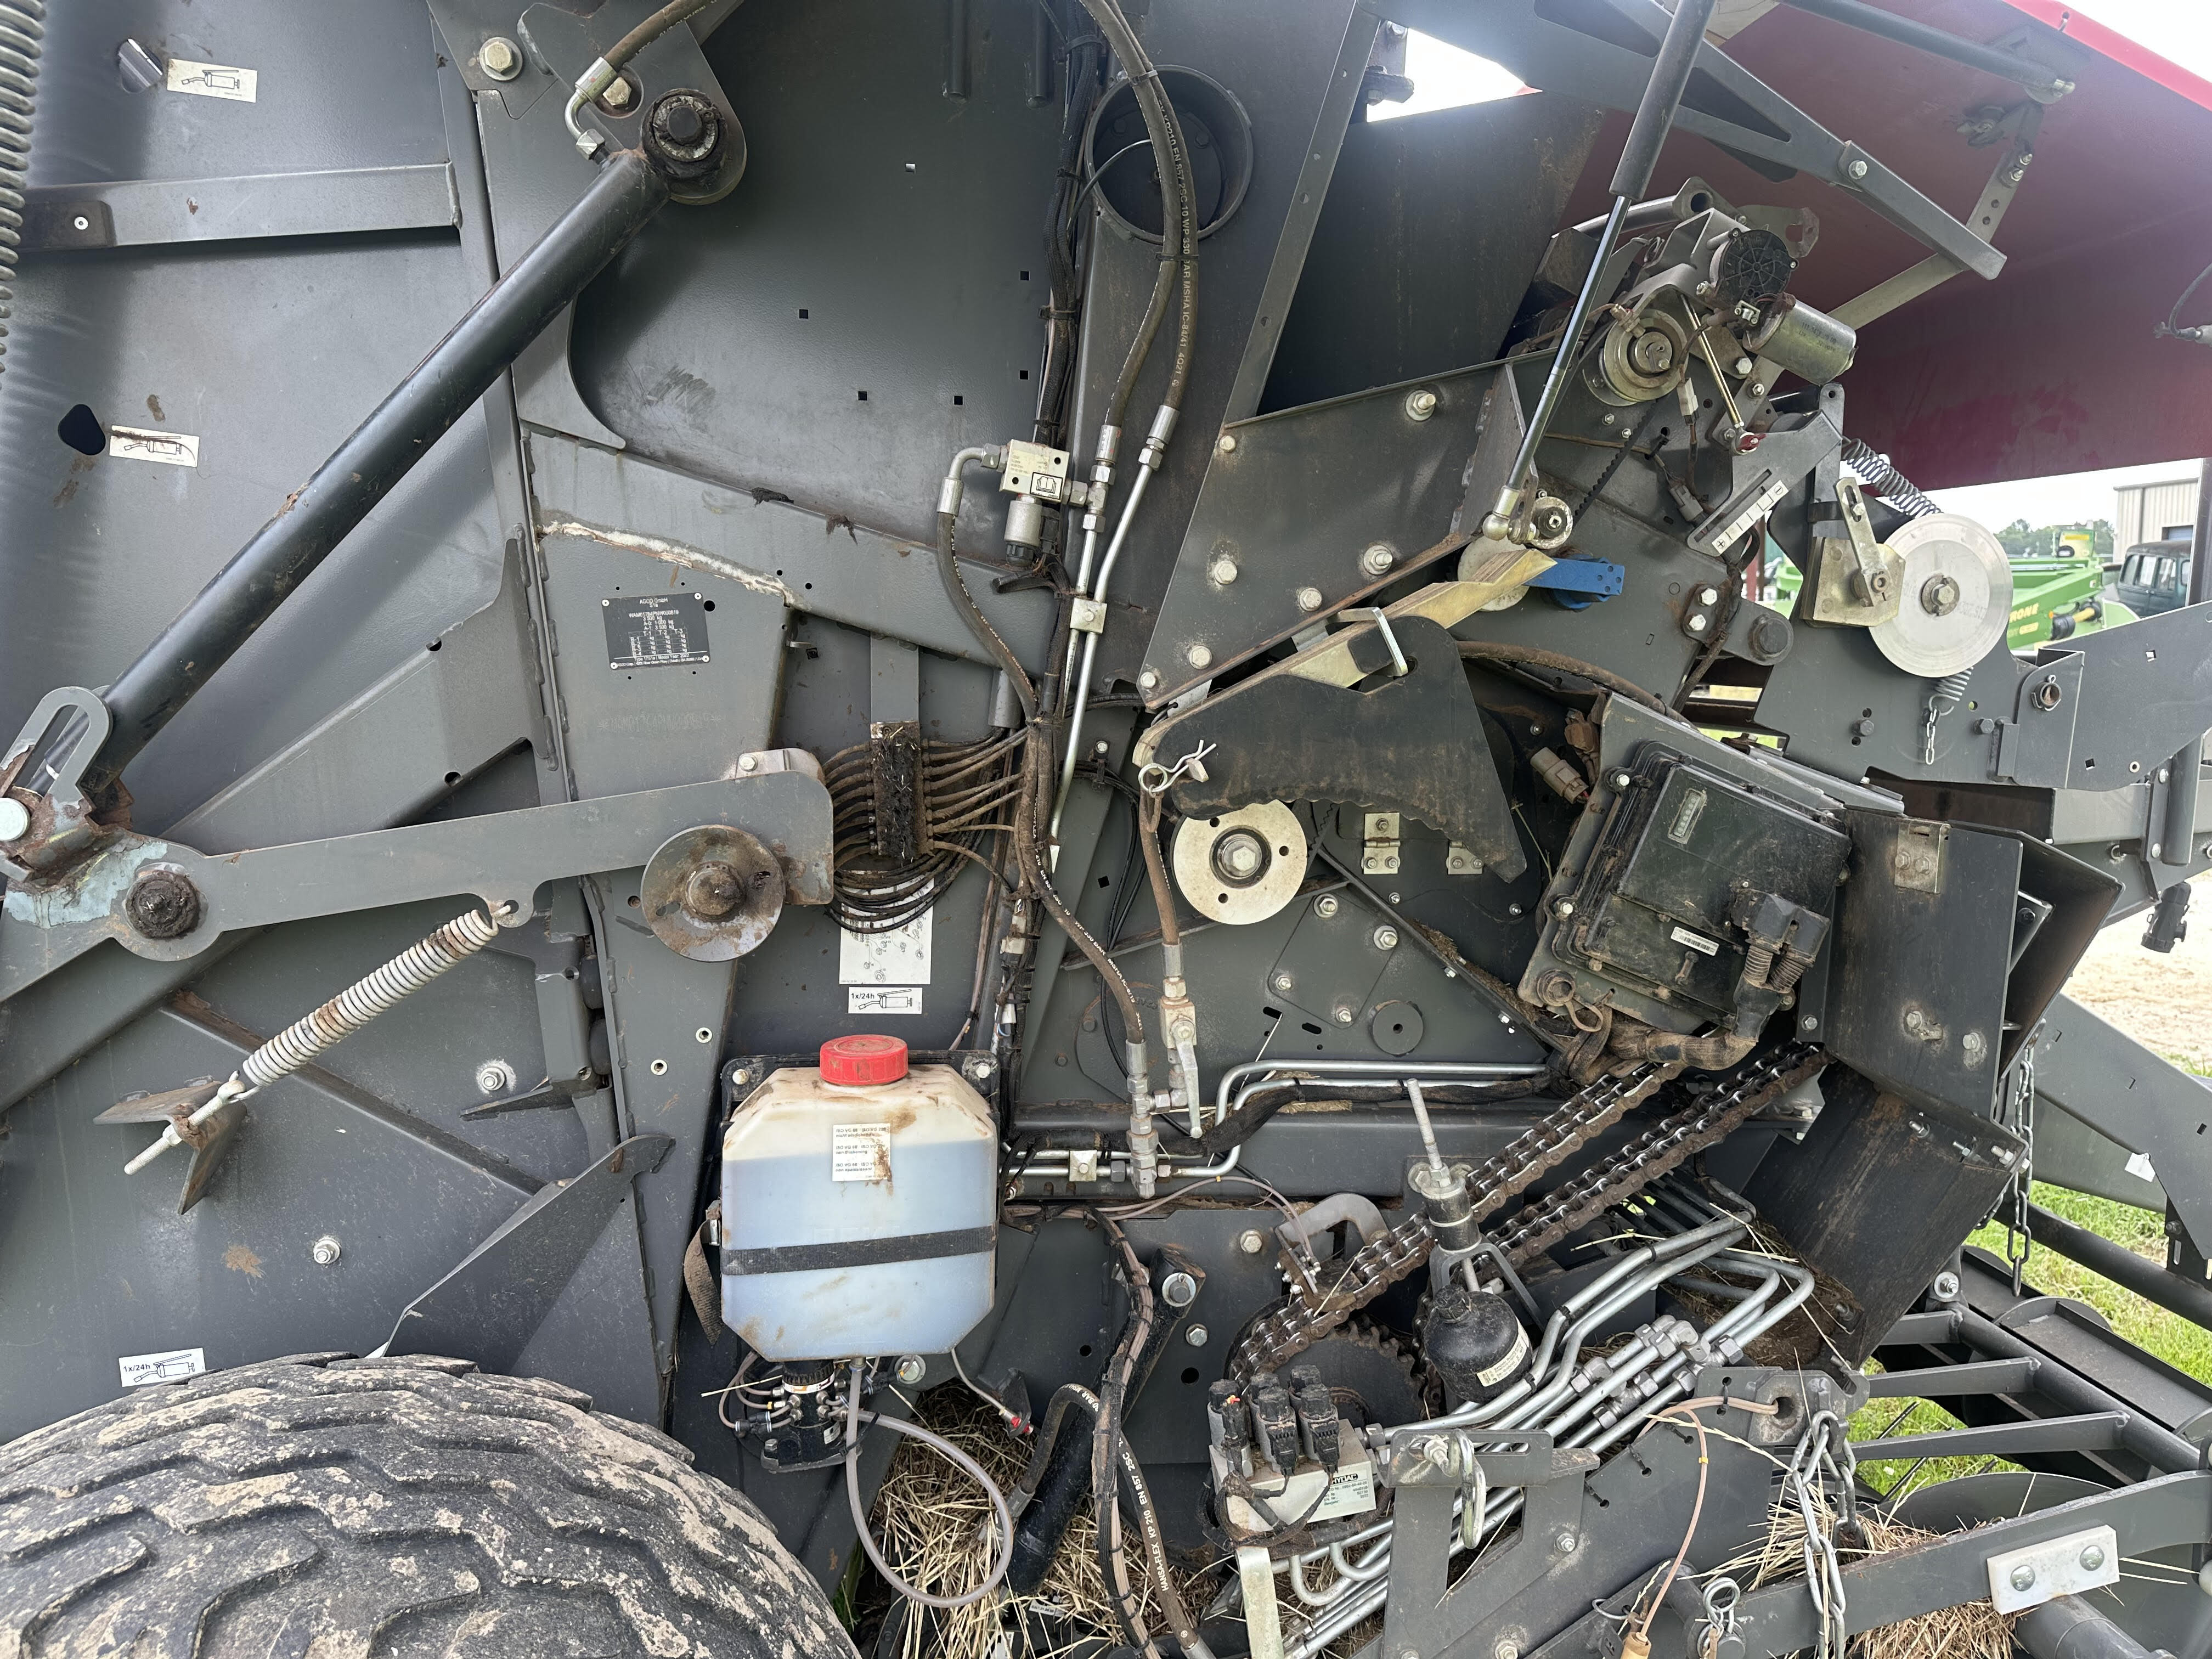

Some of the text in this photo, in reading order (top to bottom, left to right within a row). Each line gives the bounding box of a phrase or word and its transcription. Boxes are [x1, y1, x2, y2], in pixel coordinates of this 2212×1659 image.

[1172, 147, 1181, 161] EN
[1179, 183, 1188, 202] 2SC
[1181, 206, 1189, 216] 10
[1182, 218, 1190, 235] WP
[2009, 603, 2039, 623] RONE
[123, 1363, 150, 1372] 1x/24h
[1081, 1391, 1095, 1404] BAR
[1122, 1452, 1136, 1471] 2SC
[1131, 1475, 1143, 1491] 857
[1331, 1474, 1357, 1485] HYDAC
[1137, 1491, 1148, 1505] EN
[1143, 1510, 1153, 1525] 210
[1148, 1526, 1156, 1538] KP
[1152, 1541, 1169, 1592] HANSA-FLEX
